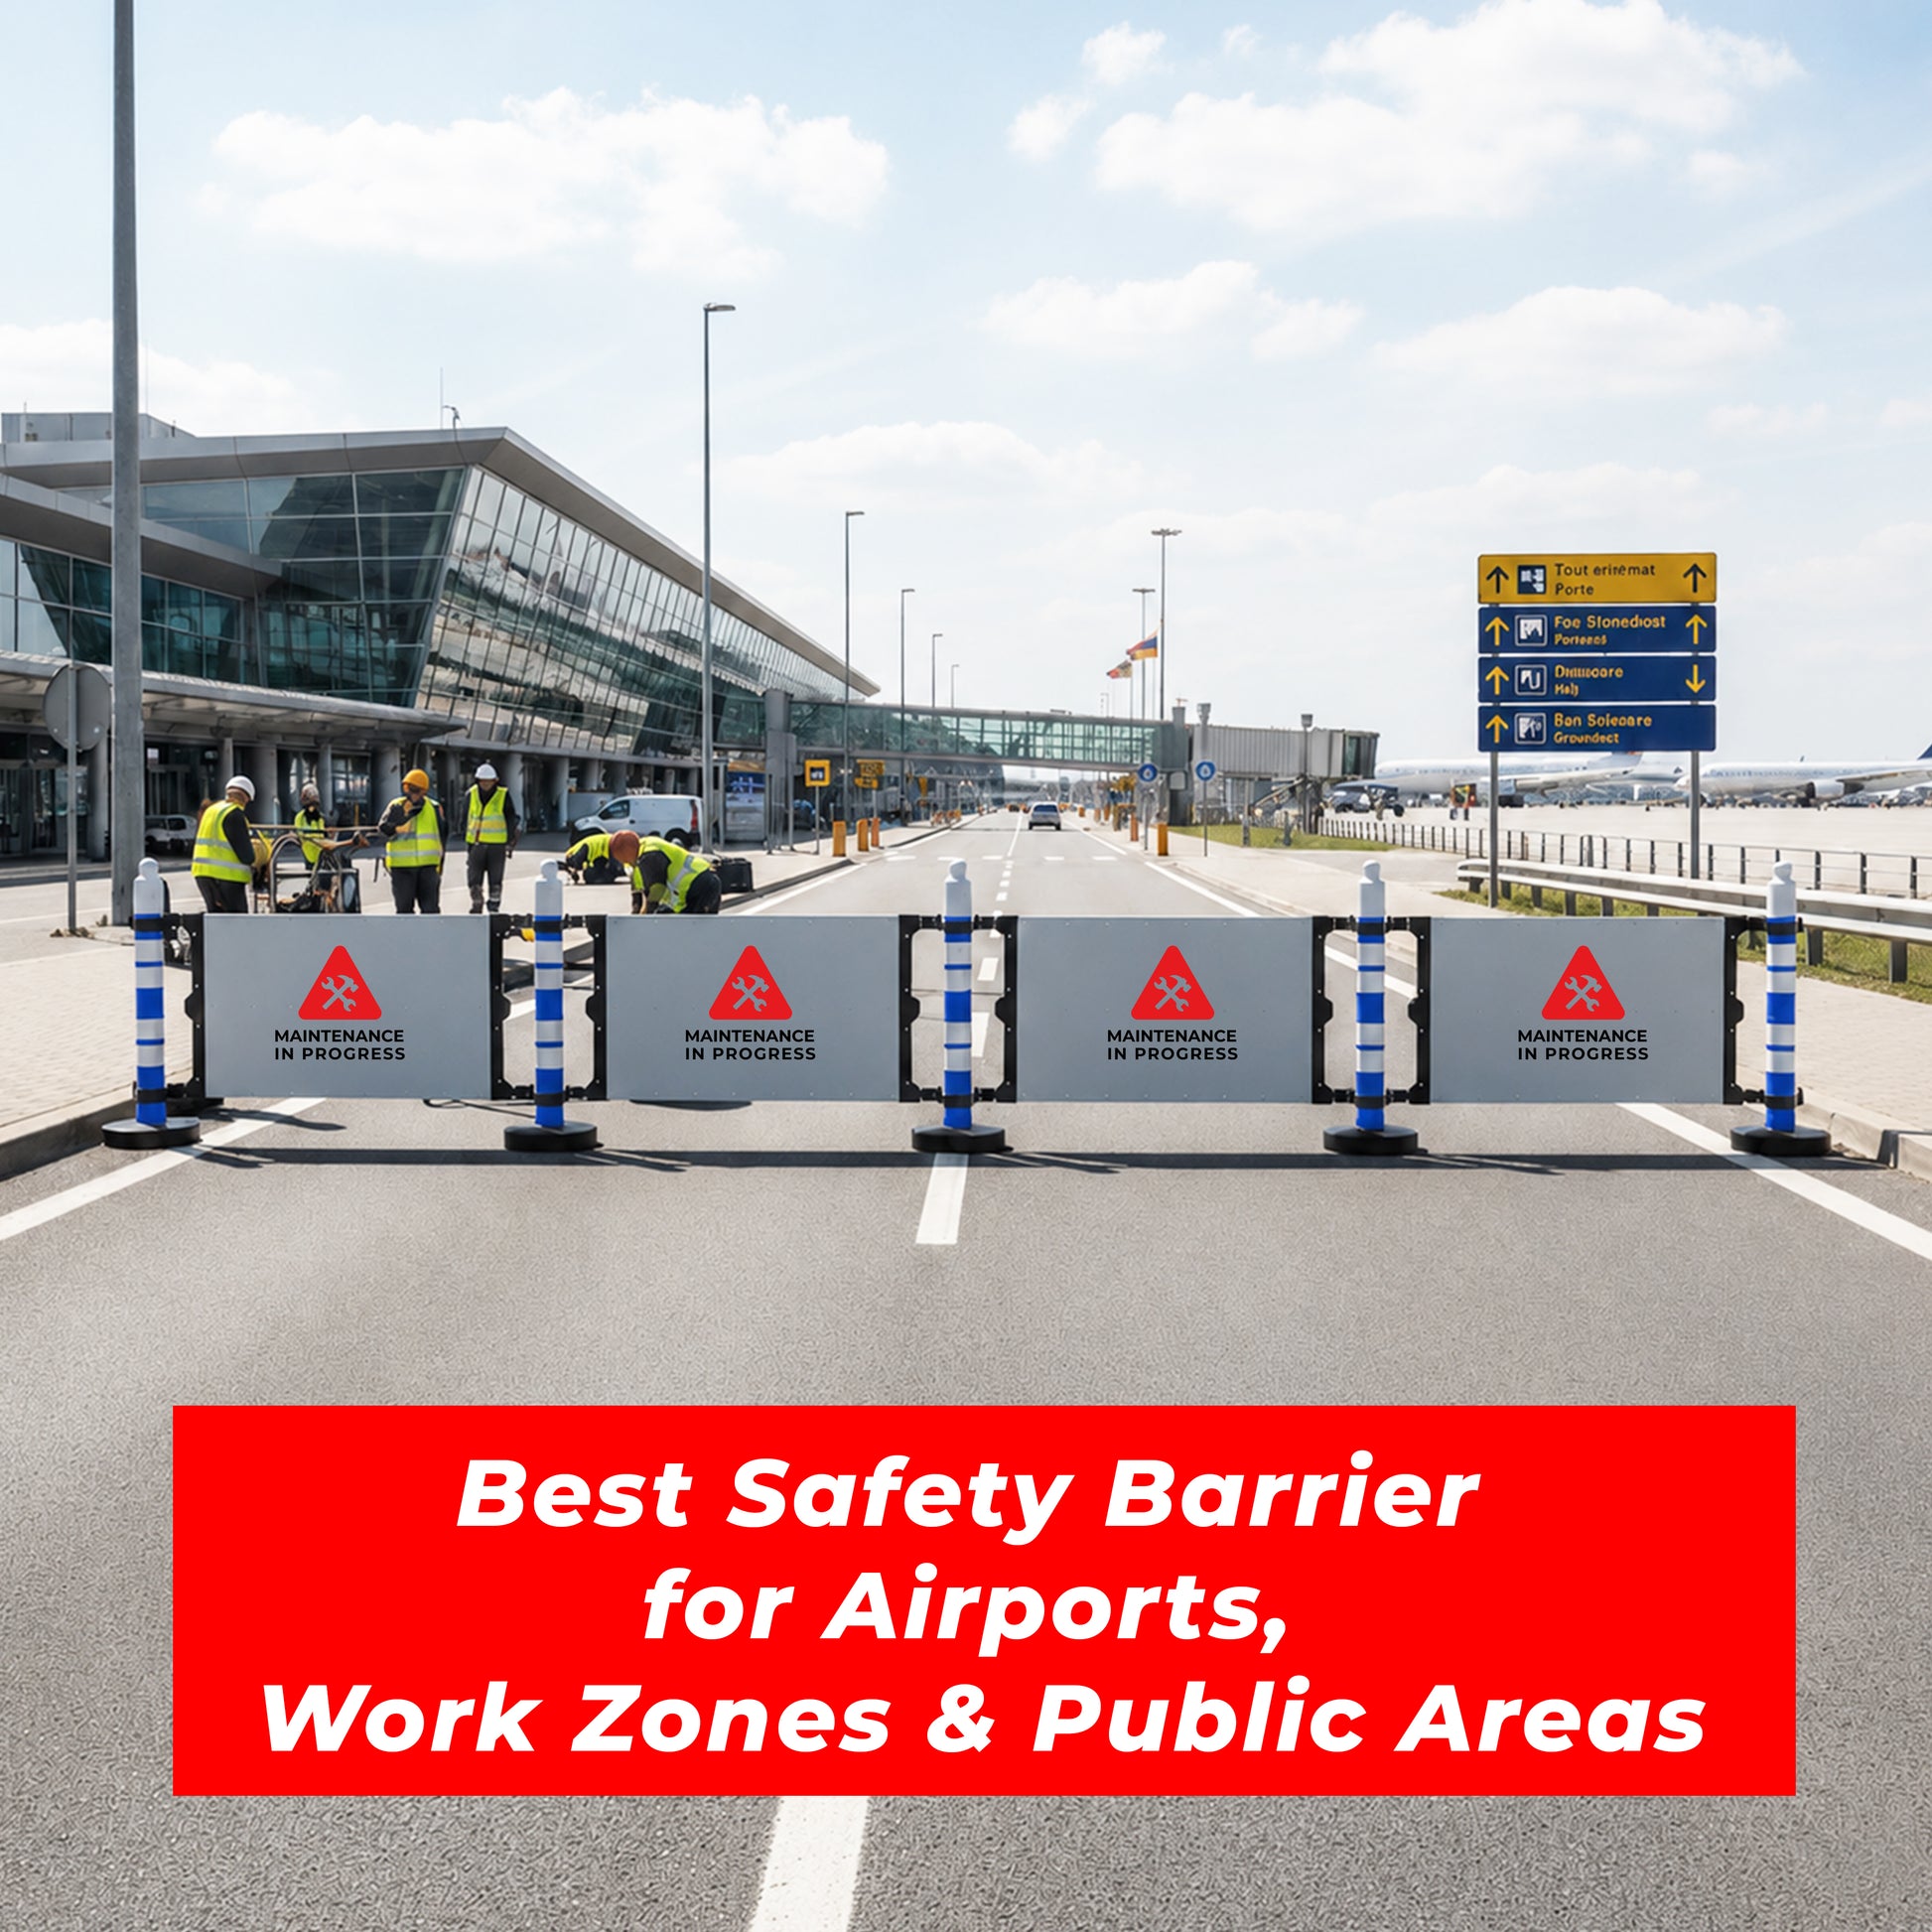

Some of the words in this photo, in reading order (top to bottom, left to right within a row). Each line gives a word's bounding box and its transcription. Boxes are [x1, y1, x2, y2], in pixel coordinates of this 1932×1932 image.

[1554, 563, 1588, 576] Tout
[1554, 582, 1594, 596] Porte
[274, 1029, 405, 1043] MAINTENANCE
[685, 1029, 815, 1043] MAINTENANCE
[1107, 1029, 1237, 1043] MAINTENANCE
[1517, 1029, 1648, 1043] MAINTENANCE
[274, 1046, 294, 1060] IN
[302, 1046, 406, 1061] PROGRESS
[685, 1046, 705, 1060] IN
[713, 1046, 816, 1061] PROGRESS
[1107, 1046, 1127, 1060] IN
[1135, 1046, 1239, 1061] PROGRESS
[1517, 1046, 1538, 1060] IN
[1545, 1046, 1649, 1061] PROGRESS
